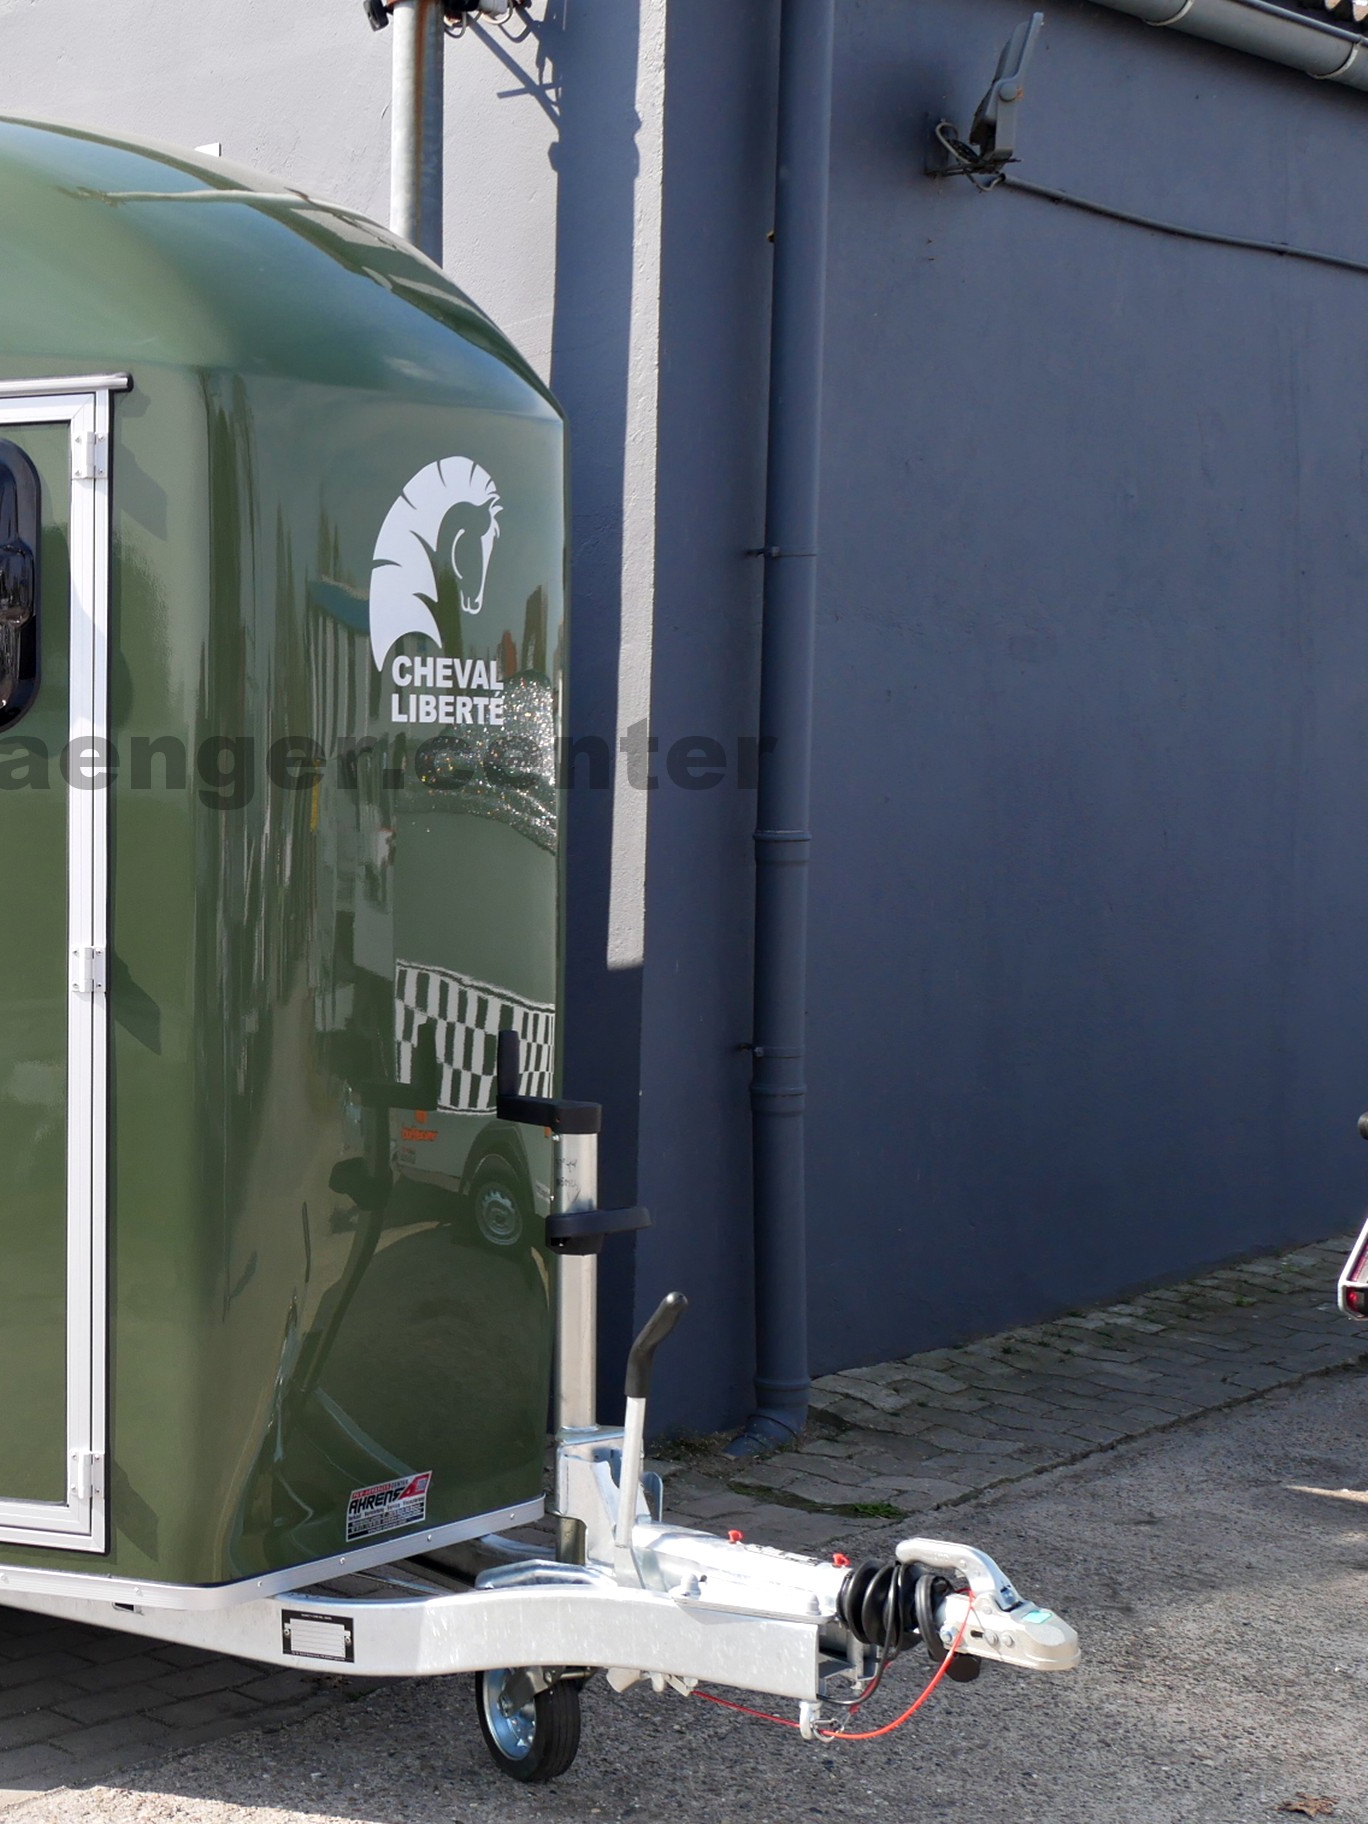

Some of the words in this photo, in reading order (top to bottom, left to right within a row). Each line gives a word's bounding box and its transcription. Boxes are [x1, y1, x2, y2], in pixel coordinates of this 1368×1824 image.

[391, 654, 504, 691] CHEVAL
[391, 691, 504, 726] LIBERTÉ
[349, 1487, 405, 1515] AHRENS
